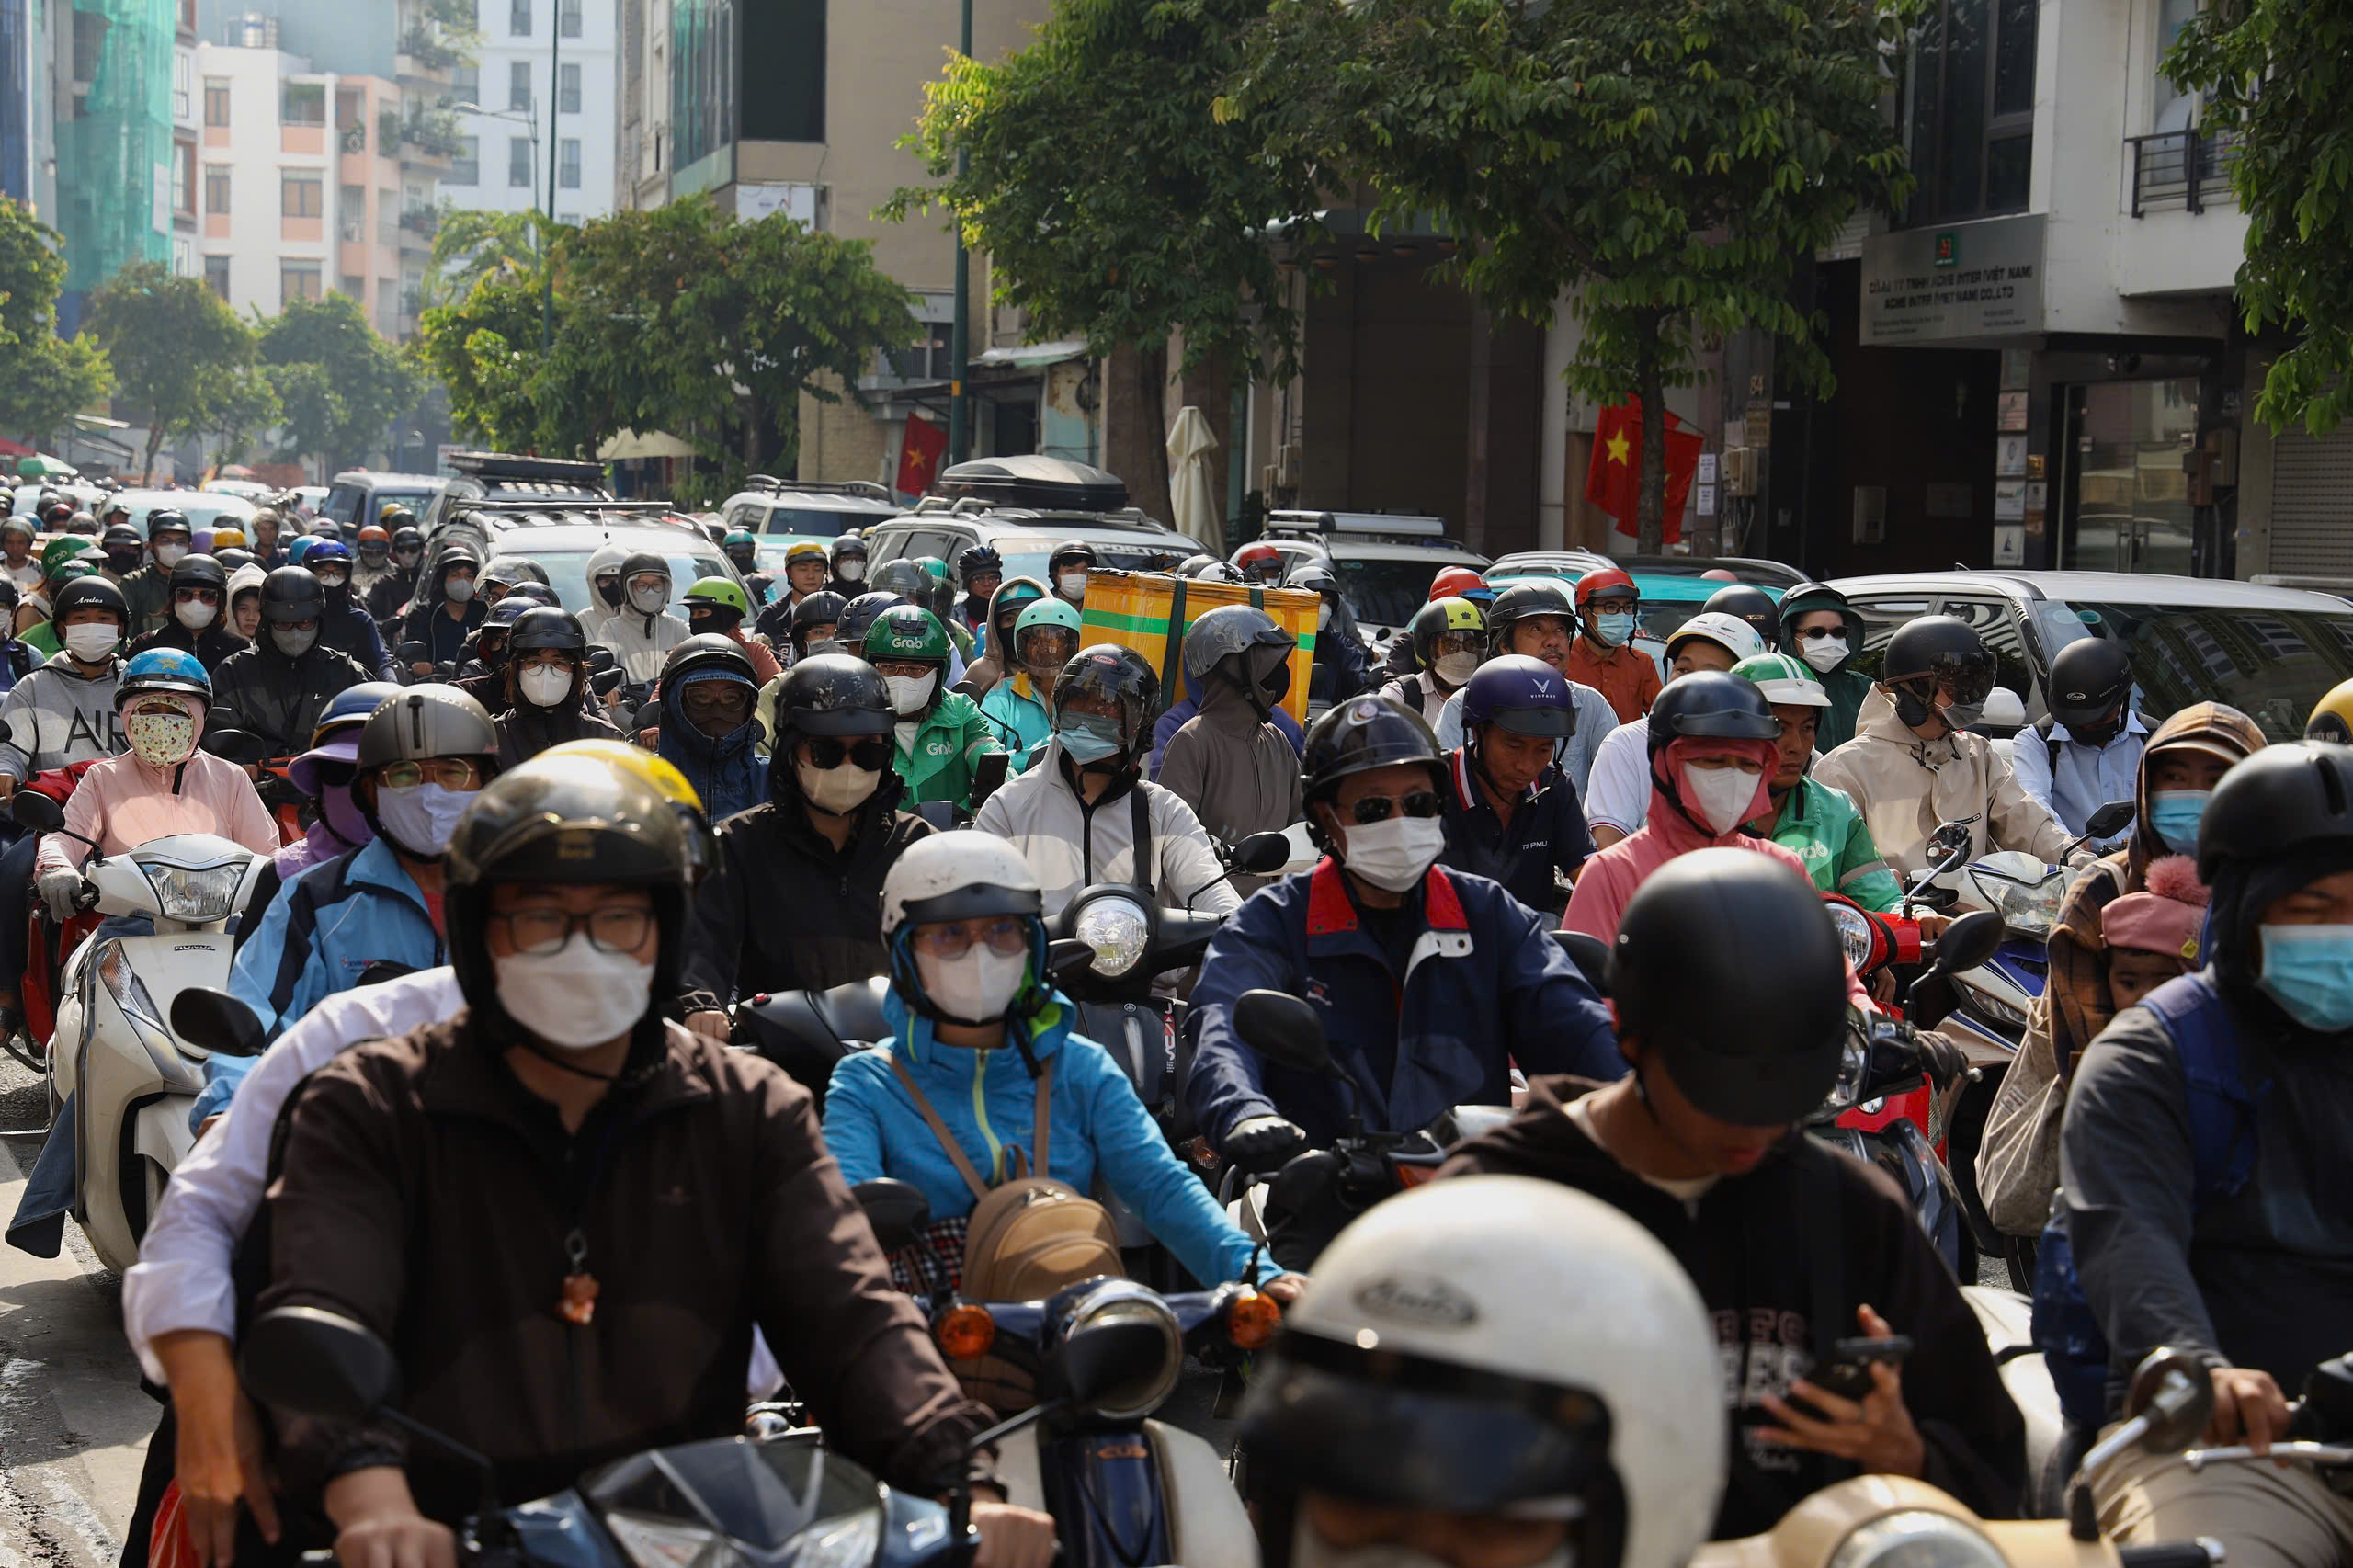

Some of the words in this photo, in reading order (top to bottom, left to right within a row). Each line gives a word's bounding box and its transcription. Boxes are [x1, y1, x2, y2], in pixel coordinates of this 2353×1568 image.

[48, 550, 68, 565] Grab
[892, 636, 923, 650] Grab
[1789, 840, 1829, 859] rab
